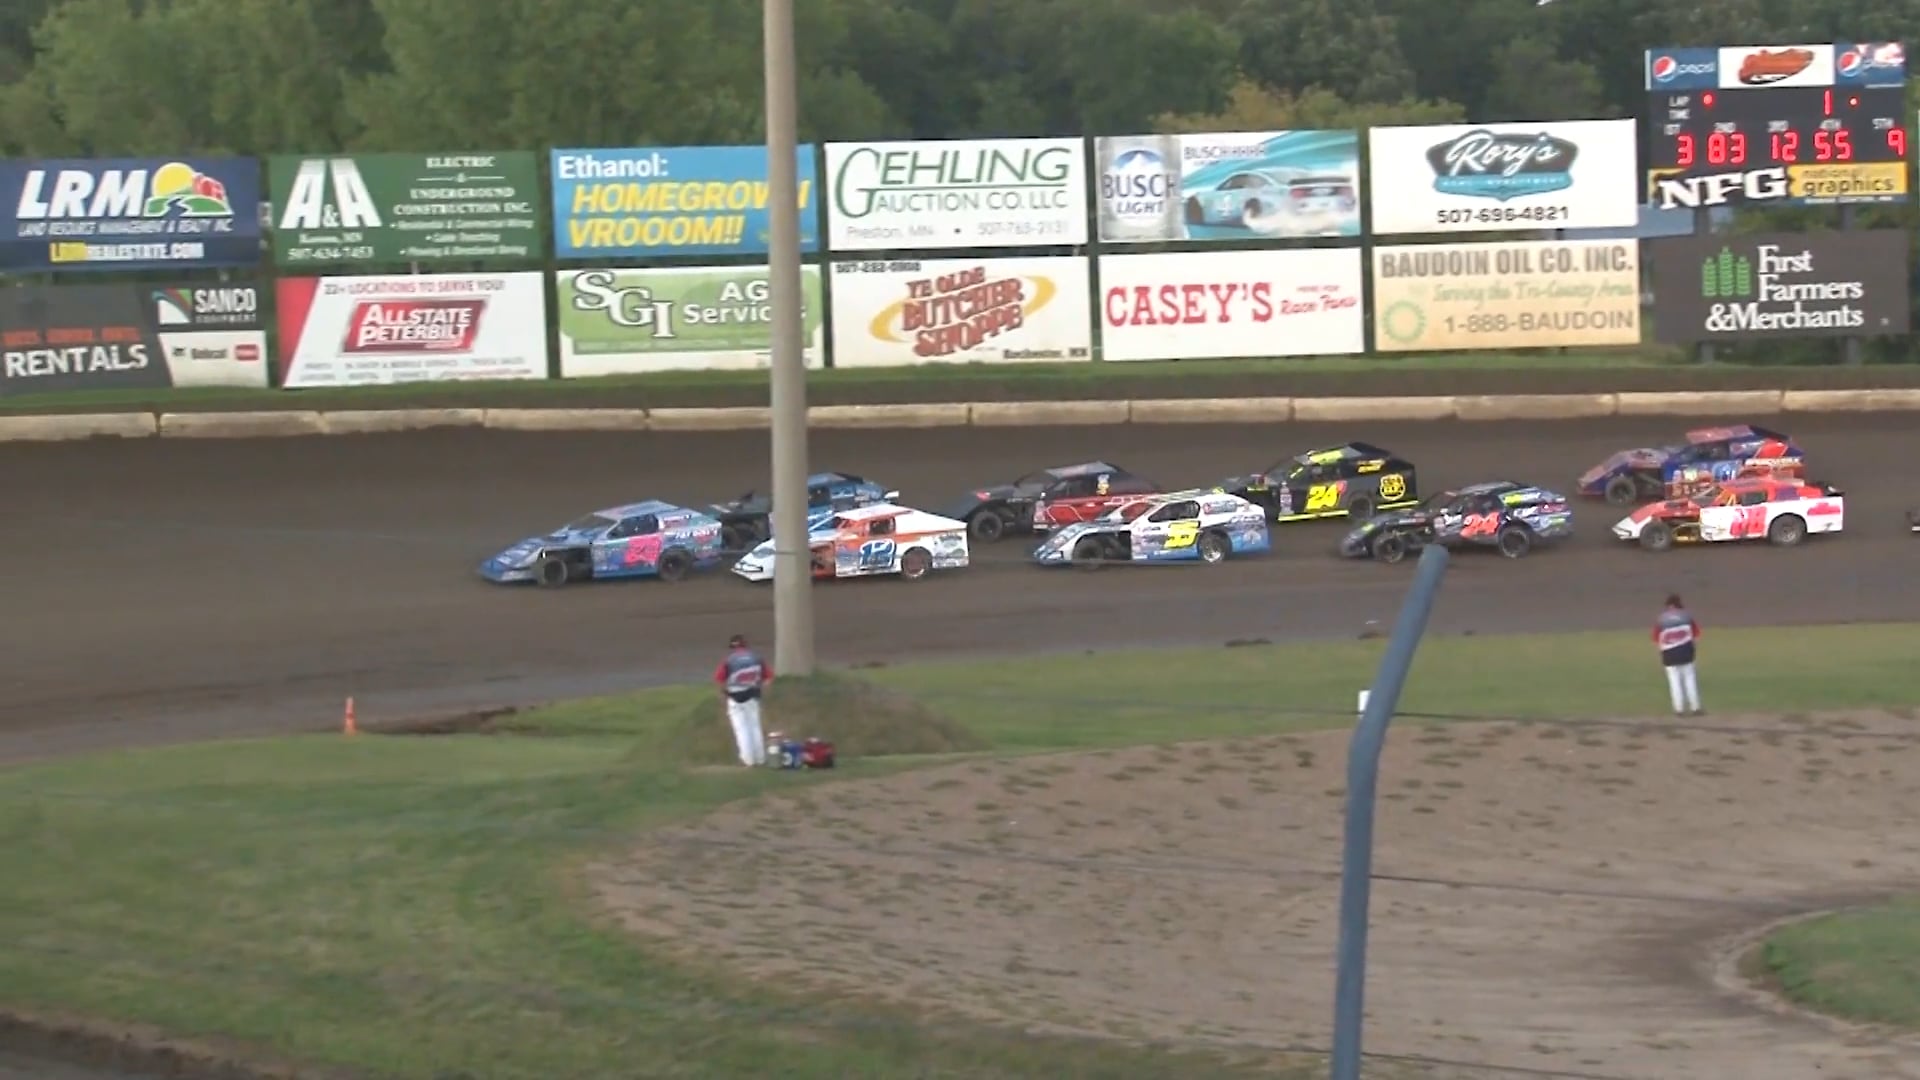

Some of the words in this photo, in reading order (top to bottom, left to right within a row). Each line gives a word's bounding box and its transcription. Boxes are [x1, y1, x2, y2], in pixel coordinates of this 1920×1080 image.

[1669, 96, 1691, 106] LAP
[1824, 90, 1833, 115] 1
[1669, 109, 1691, 119] TIME
[1872, 118, 1895, 129] 5TH
[1445, 133, 1561, 177] Rory's
[1677, 134, 1694, 165] 3
[1707, 133, 1746, 164] 83
[1771, 131, 1798, 162] 12
[1813, 130, 1852, 160] 55
[1887, 128, 1905, 156] 9
[426, 156, 495, 168] ELECTRIC
[558, 153, 669, 179] Ethanol:
[1803, 166, 1863, 179] national
[16, 169, 148, 218] LRM
[279, 158, 382, 229] A&A
[410, 187, 515, 200] UNDERGROUND
[834, 147, 1071, 219] GEHLING
[1102, 174, 1177, 199] BUSCH
[1658, 167, 1787, 210] NFG
[1802, 175, 1894, 195] graphics
[393, 203, 499, 216] CONSTRUCTION
[503, 202, 533, 214] INC.
[874, 192, 980, 213] AUCTION
[985, 191, 1025, 211] CO.
[1028, 190, 1069, 209] LLC
[1117, 200, 1164, 214] LIGHT
[569, 215, 745, 248] VROOOM!!
[1381, 250, 1489, 278] BAUDOIN
[1496, 249, 1533, 274] OIL
[1540, 247, 1579, 273] CO.
[1585, 245, 1633, 272] INC.
[1757, 245, 1813, 273] First
[349, 281, 416, 295] LOCATIONS
[419, 281, 434, 293] TO
[438, 280, 474, 292] SERVE
[906, 279, 933, 298] YE
[936, 266, 985, 293] OLDE
[1433, 283, 1485, 310] Serving
[1488, 281, 1511, 299] the
[1758, 273, 1864, 302] Farmers
[194, 288, 256, 313] SANCO
[361, 304, 473, 325] ALLSTATE
[573, 269, 676, 338] SGI
[683, 301, 807, 324] Servic
[901, 277, 1024, 332] BUTCHER
[1106, 282, 1273, 327] CASEY'S
[1280, 300, 1317, 316] Race
[1320, 294, 1357, 312] Fans
[913, 303, 1023, 357] SHOPPE
[1444, 311, 1633, 333] 1-888-BAUDOIN
[1705, 301, 1864, 331] &Merchants
[357, 323, 469, 347] PETERBILT
[5, 344, 149, 377] RENTALS
[1305, 482, 1341, 510] 24
[860, 539, 897, 570] 12
